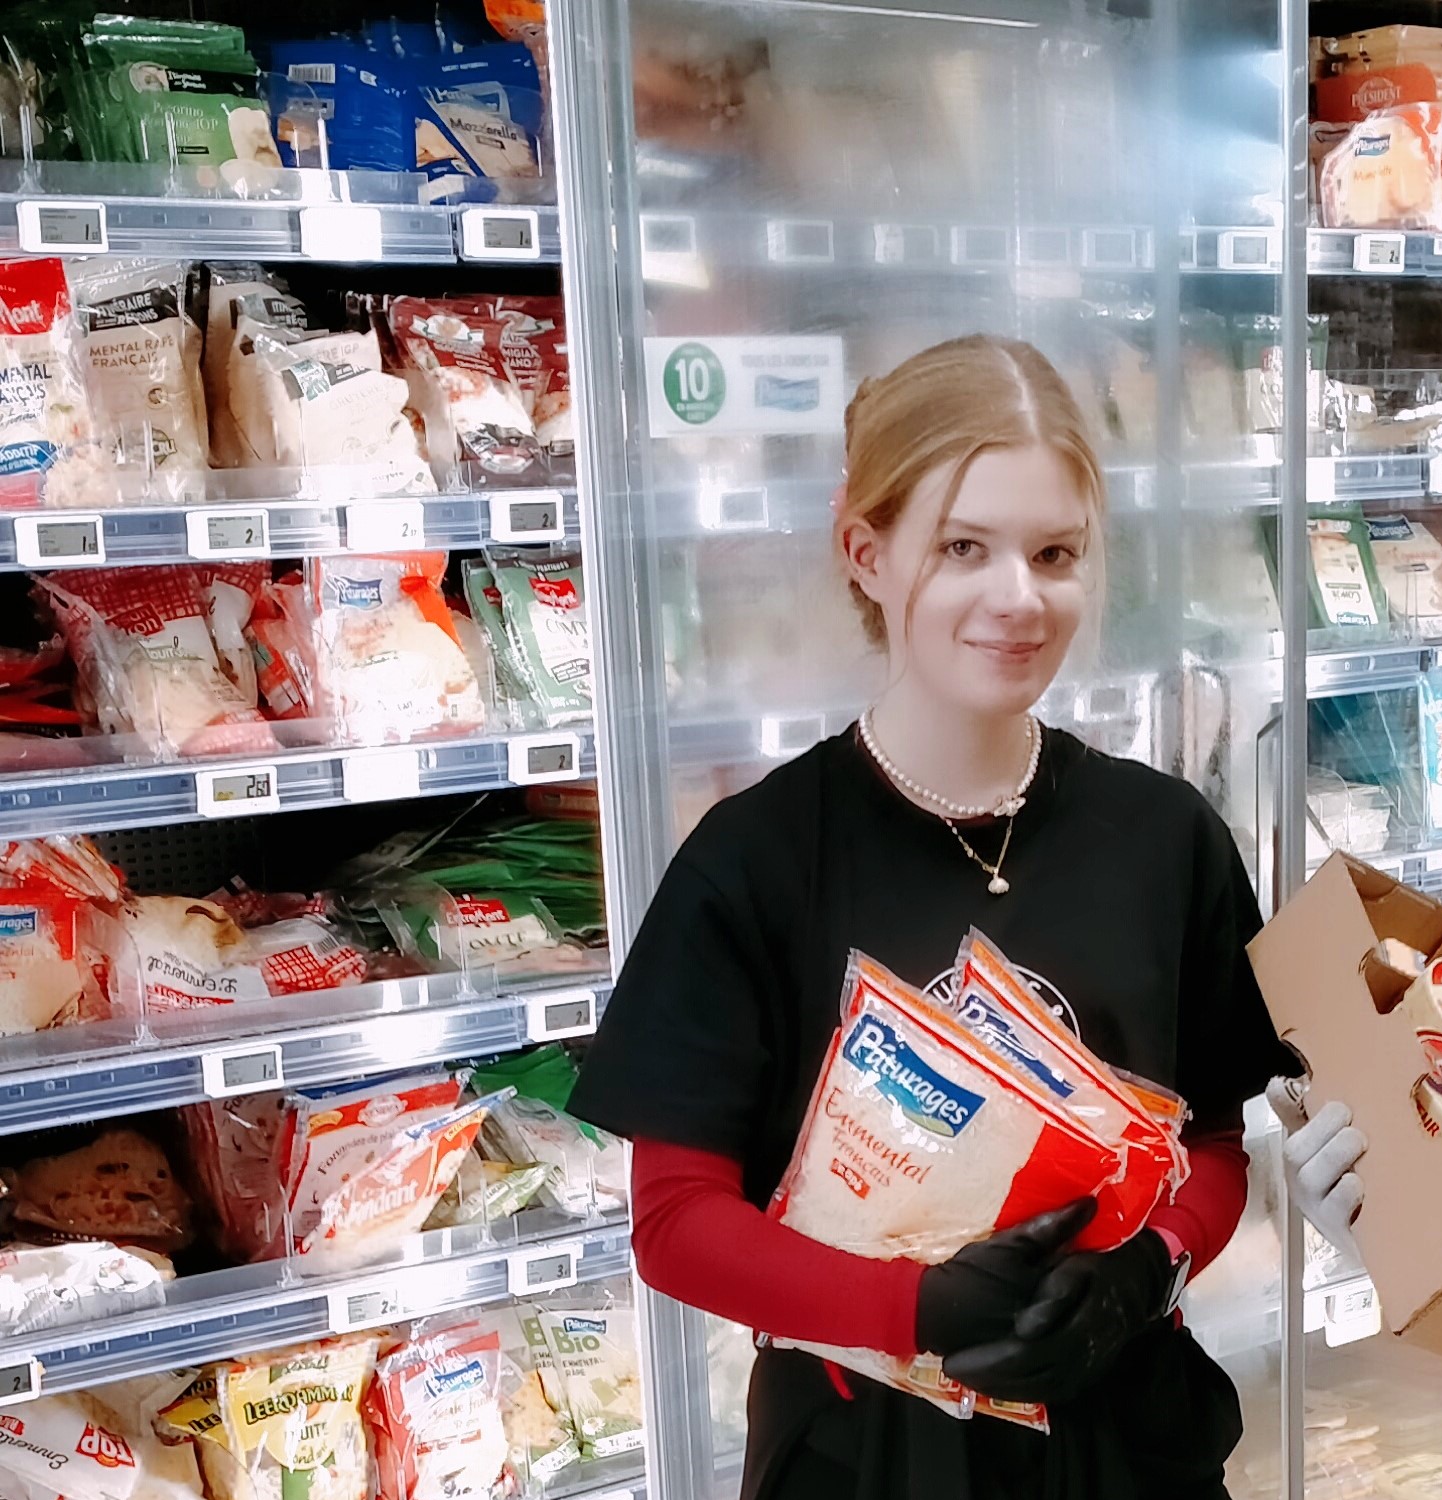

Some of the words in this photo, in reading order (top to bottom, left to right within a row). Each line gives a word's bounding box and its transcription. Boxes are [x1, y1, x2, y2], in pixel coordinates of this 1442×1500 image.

[449, 117, 518, 142] Mozzarella
[674, 357, 711, 402] 10
[849, 1022, 969, 1126] Pâturages
[825, 1086, 934, 1185] Emmental
[551, 1325, 601, 1355] Bio
[425, 1365, 483, 1398] Pâturages
[80, 1429, 133, 1464] TOP
